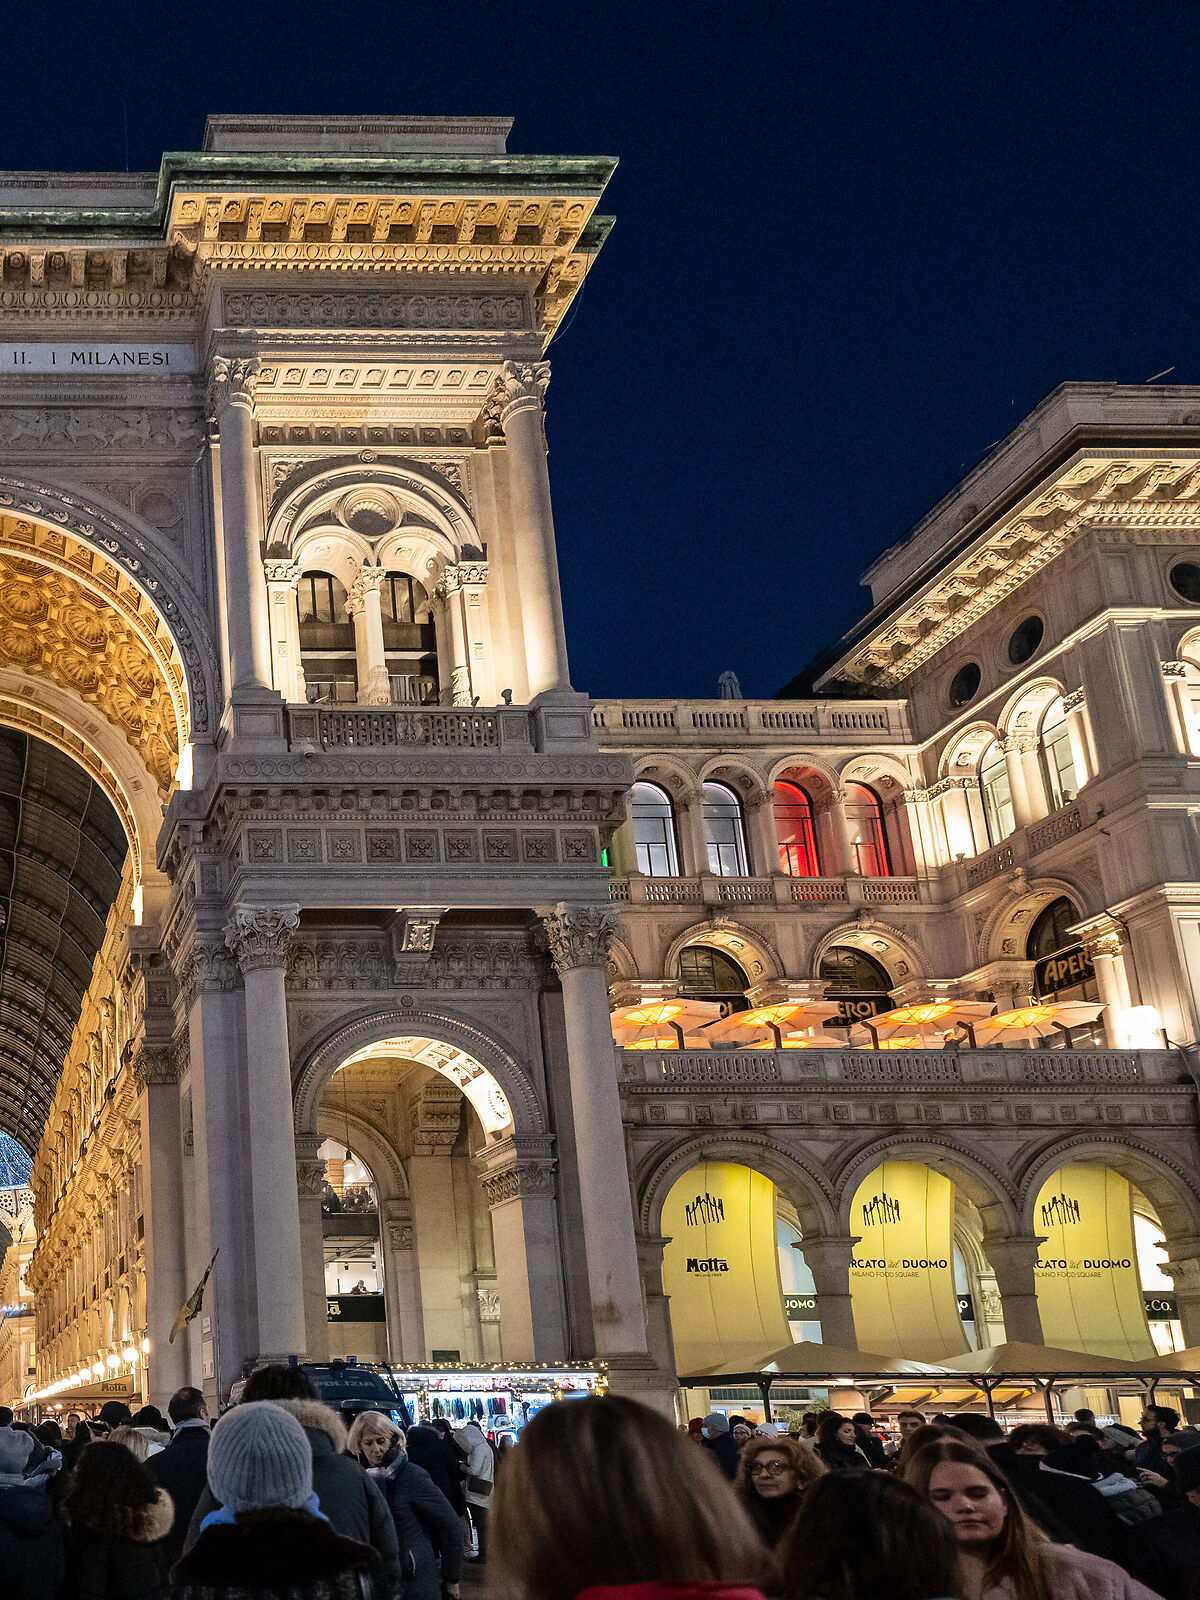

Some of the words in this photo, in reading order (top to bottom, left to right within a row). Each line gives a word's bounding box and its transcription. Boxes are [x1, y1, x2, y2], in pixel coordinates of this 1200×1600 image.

[13, 352, 32, 364] II.
[71, 352, 170, 365] MILANESI
[686, 1258, 729, 1273] Motta
[902, 1259, 948, 1269] DUOMO
[1084, 1259, 1131, 1269] DUOMO
[1151, 1300, 1173, 1311] Co.
